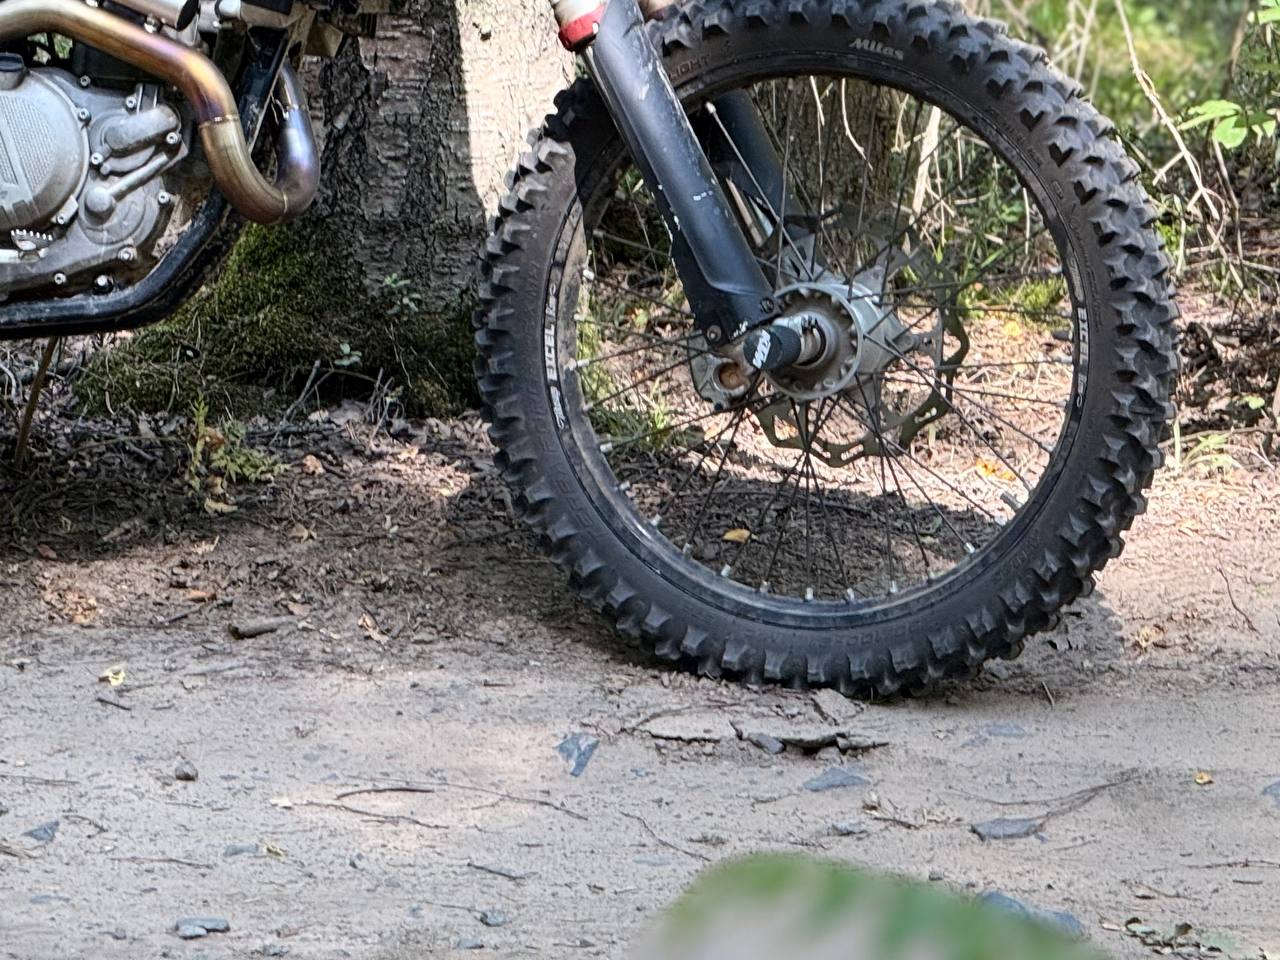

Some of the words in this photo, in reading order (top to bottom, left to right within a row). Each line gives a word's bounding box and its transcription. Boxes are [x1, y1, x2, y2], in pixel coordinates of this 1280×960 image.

[544, 323, 558, 381] EXCEL
[752, 329, 771, 369] KTM
[1077, 307, 1089, 366] EXCEL
